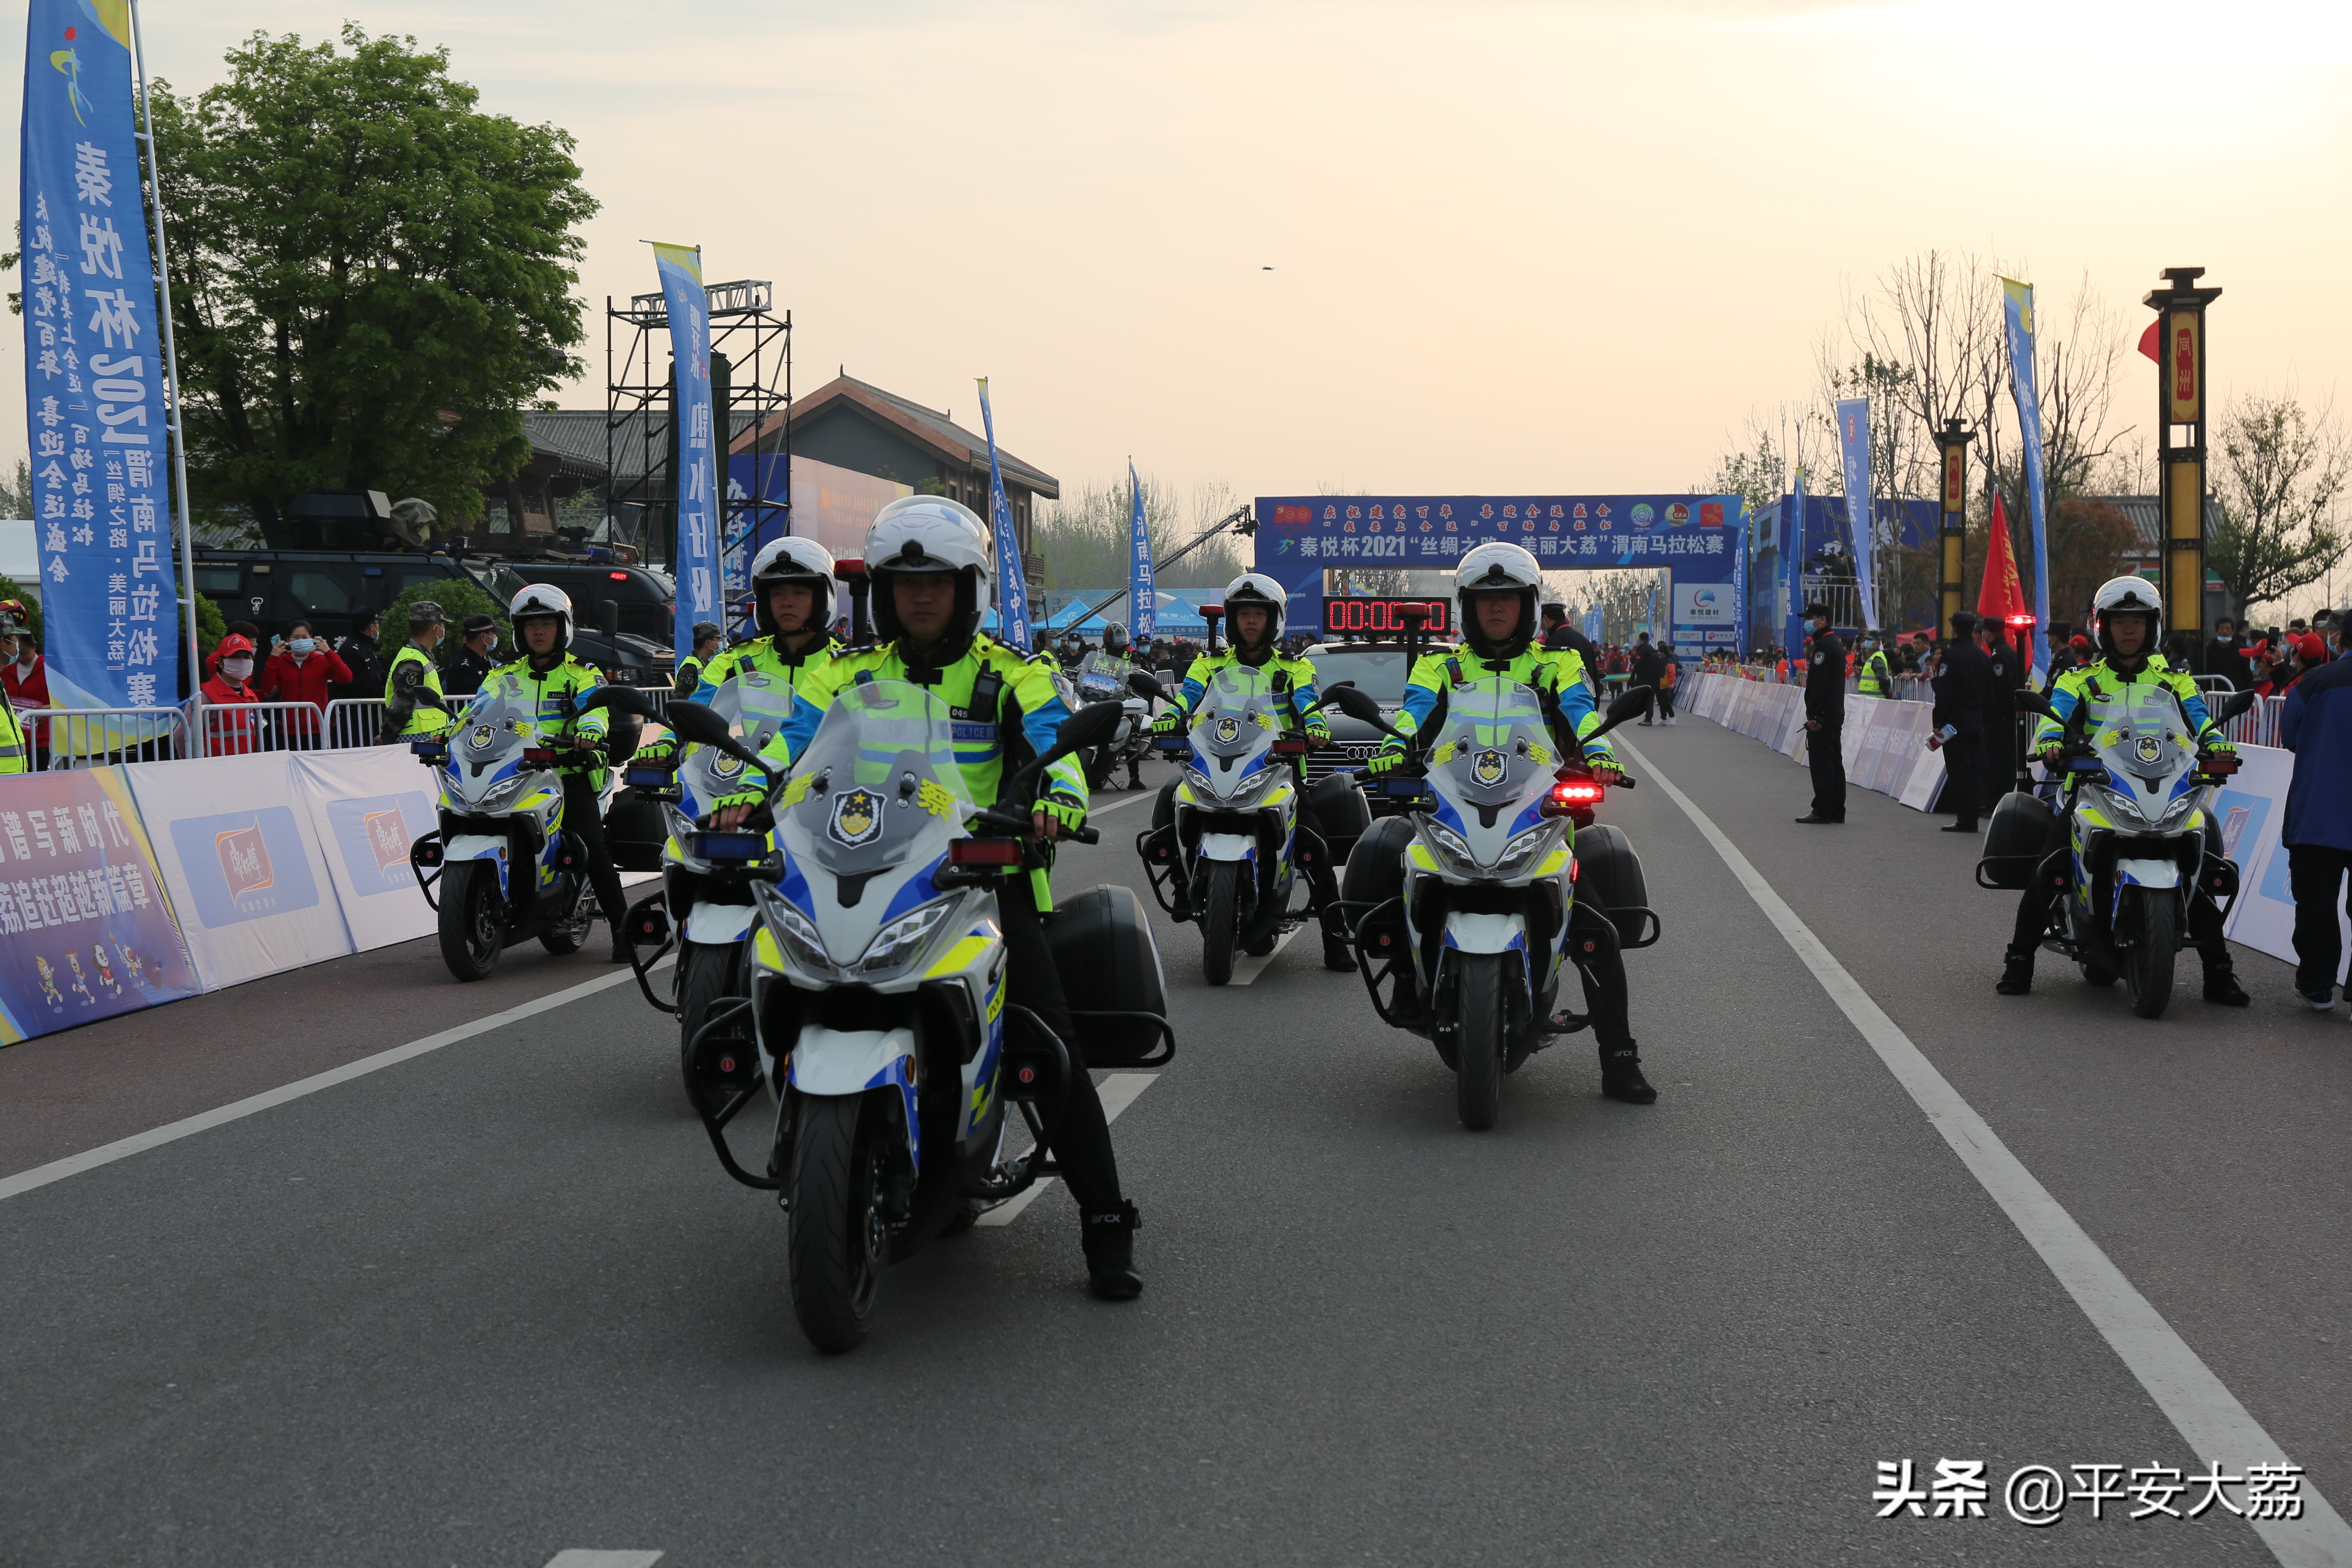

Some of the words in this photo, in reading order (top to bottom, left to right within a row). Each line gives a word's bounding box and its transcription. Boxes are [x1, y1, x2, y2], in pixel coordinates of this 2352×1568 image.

[1324, 504, 1452, 519] 庆祝建党百年
[1480, 503, 1611, 519] 喜迎全运盛会
[1497, 520, 1612, 532] 百场马拉松
[514, 720, 533, 740] 察
[1528, 741, 1552, 769] 察
[916, 778, 956, 822] 察
[0, 800, 129, 862] 谱写新时代
[548, 815, 561, 834] POLICE
[0, 863, 150, 935] 荔追赶超越新篇章
